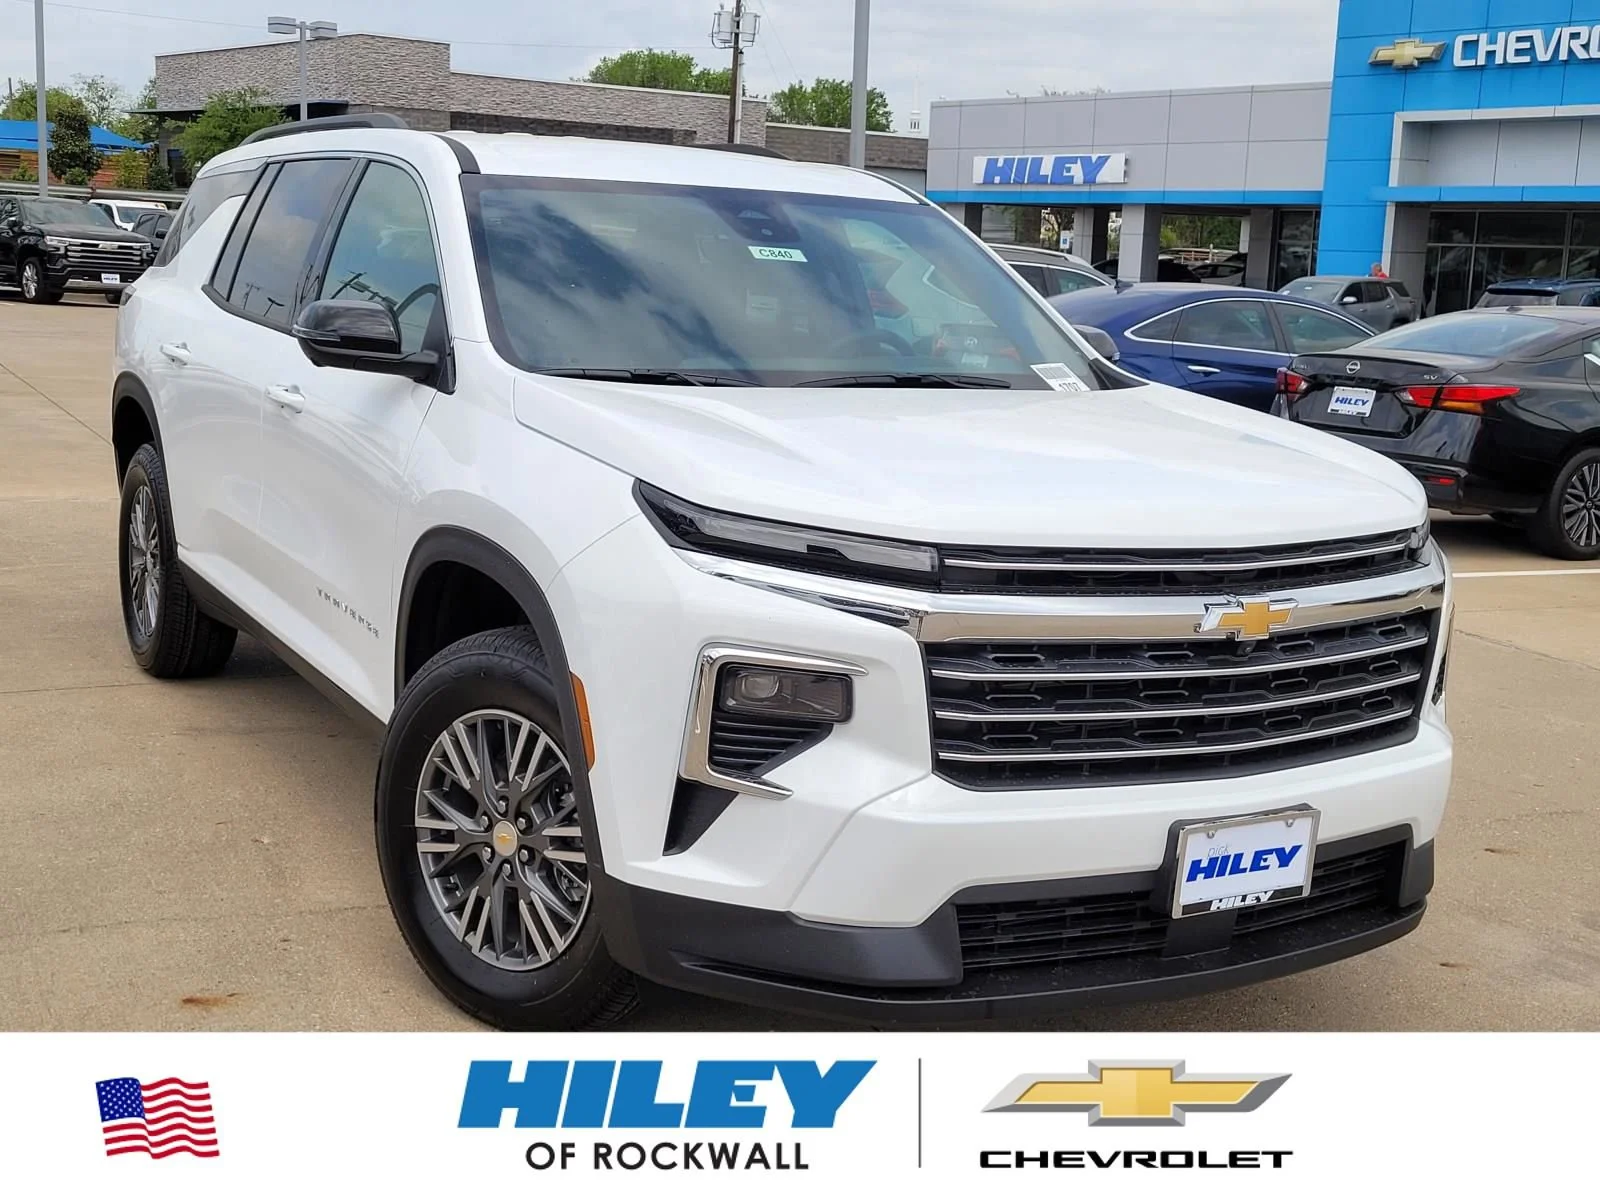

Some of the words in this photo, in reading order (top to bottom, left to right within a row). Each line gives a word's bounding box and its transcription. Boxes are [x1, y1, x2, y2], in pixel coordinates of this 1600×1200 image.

[983, 155, 1112, 185] HILEY
[1334, 396, 1370, 407] HILEY
[1185, 844, 1303, 883] HILEY
[1210, 890, 1275, 911] HILEY
